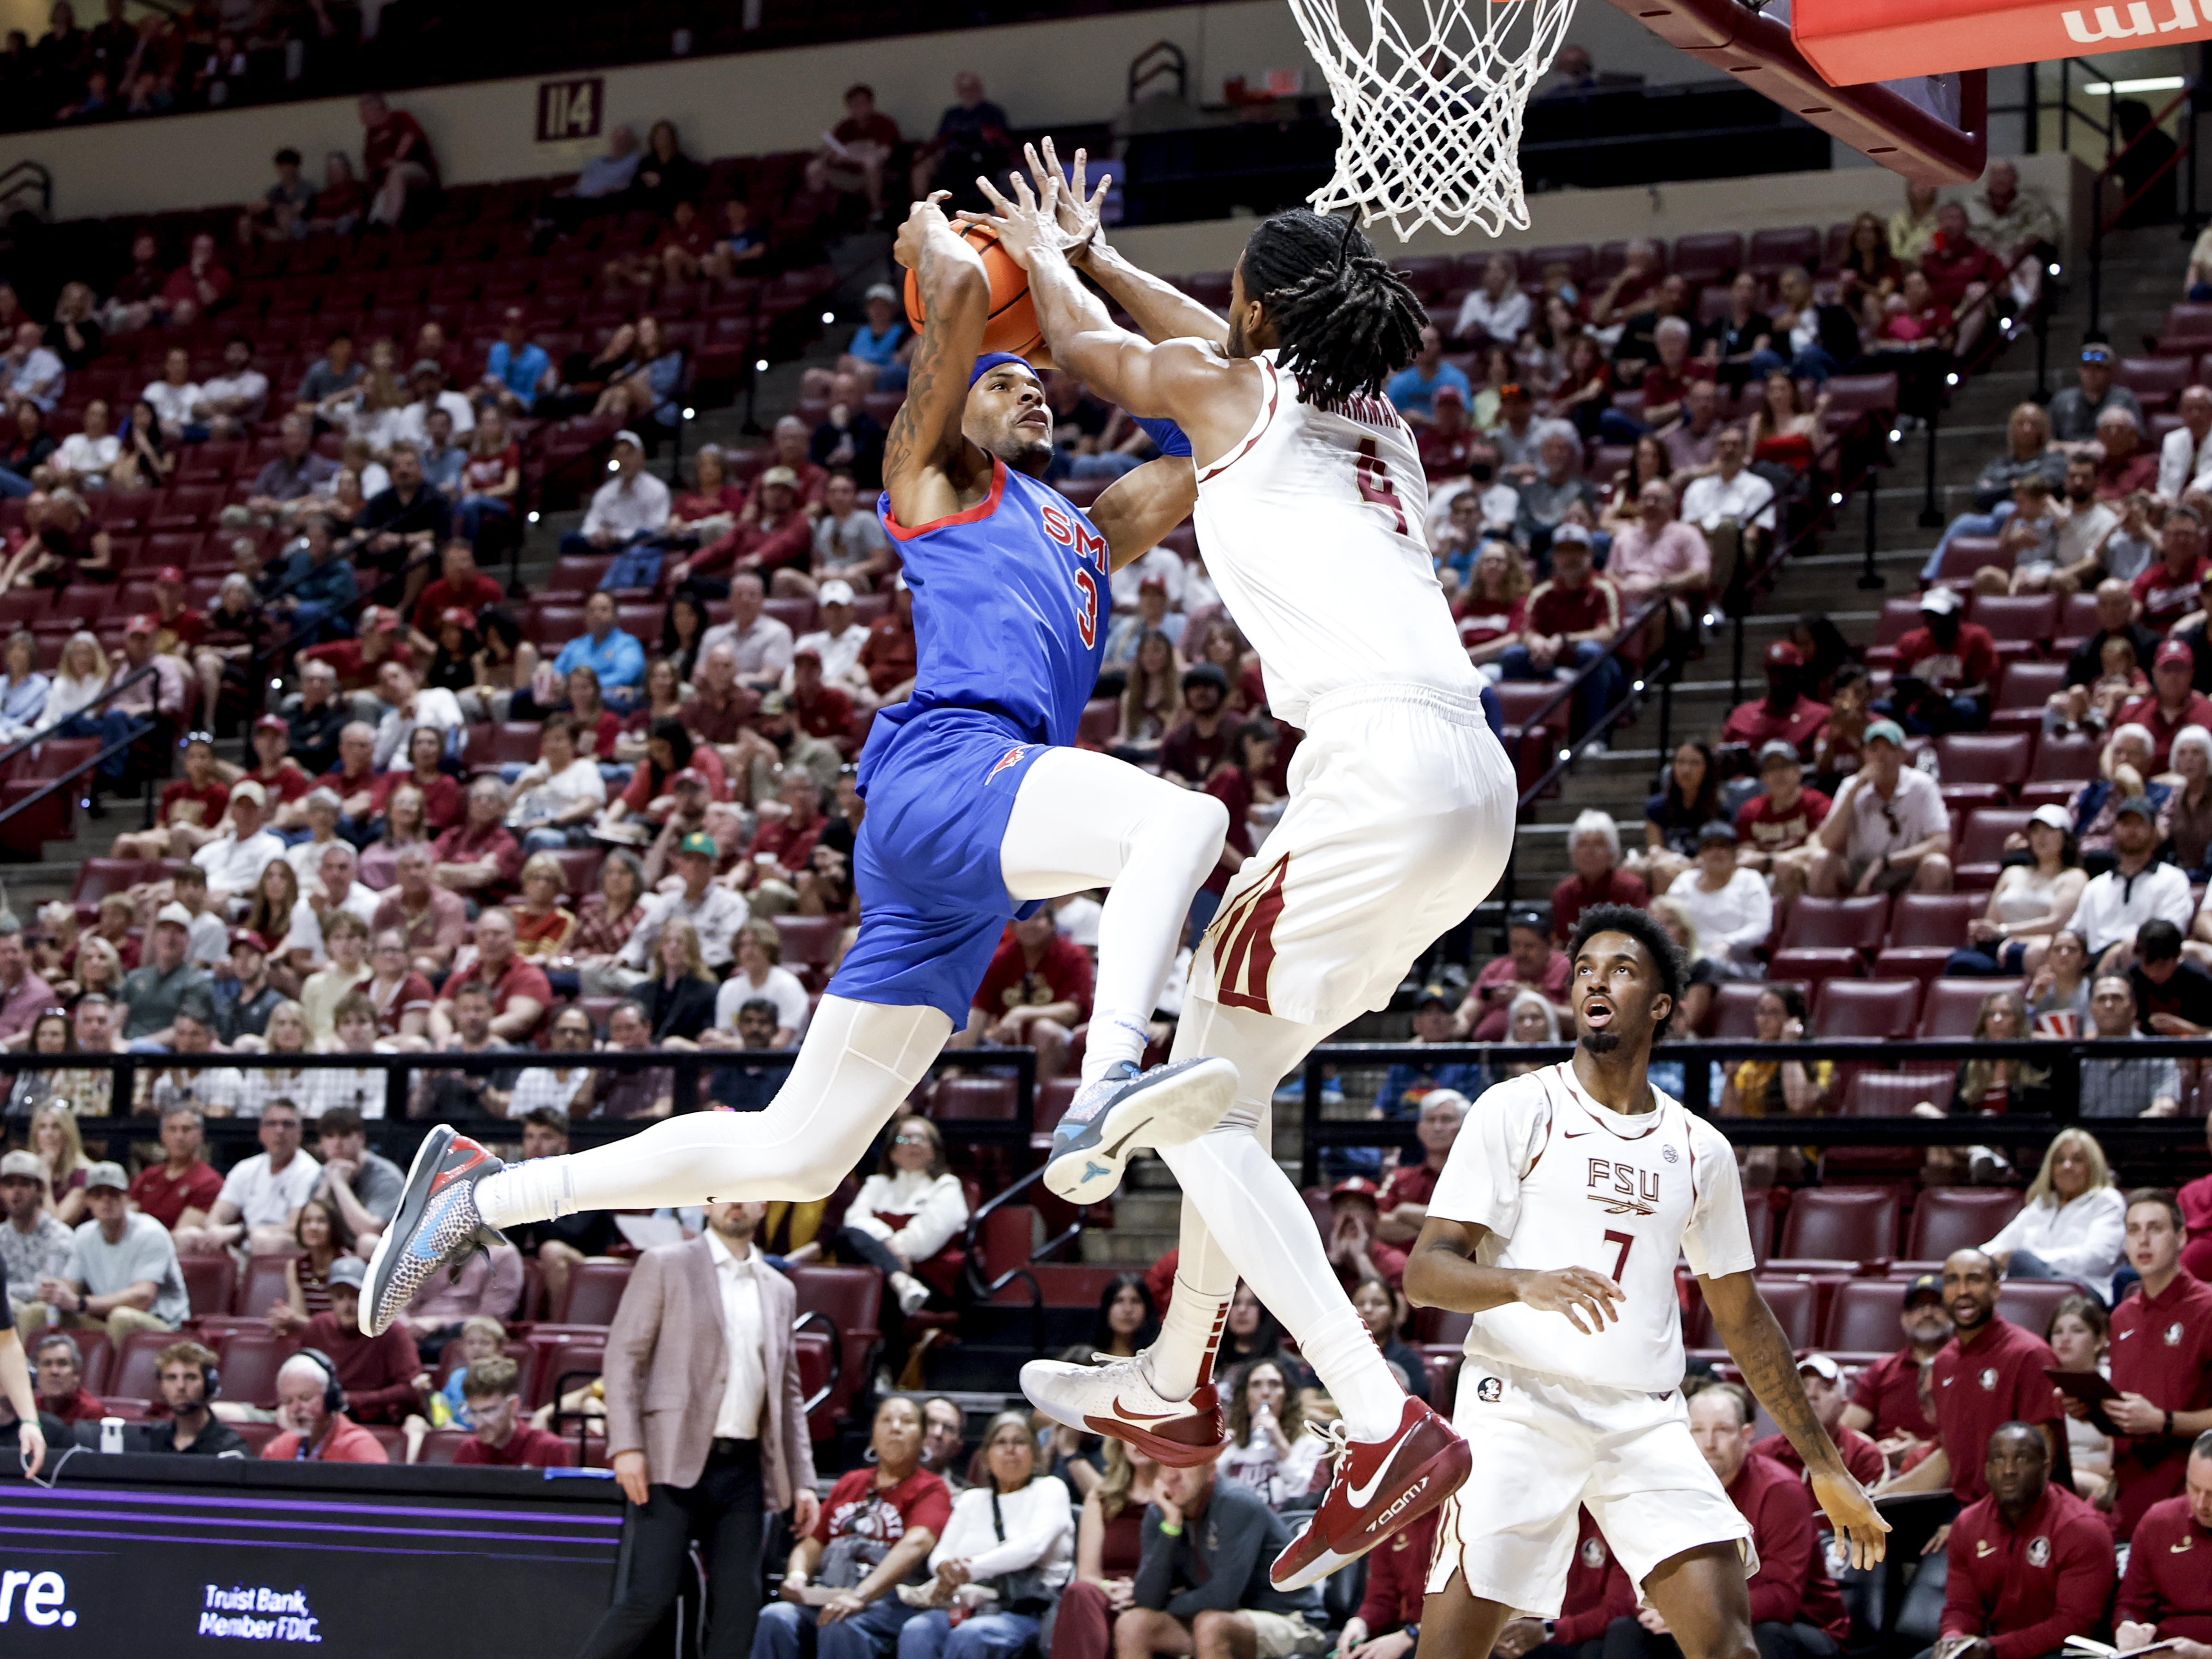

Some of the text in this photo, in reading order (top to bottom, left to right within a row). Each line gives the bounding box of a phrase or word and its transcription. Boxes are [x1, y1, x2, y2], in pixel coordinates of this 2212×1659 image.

[2061, 0, 2212, 42] rm
[546, 82, 593, 135] 114
[1354, 435, 1409, 536] 4
[1040, 505, 1112, 576] SM
[1075, 567, 1098, 650] 3
[1587, 1158, 1659, 1202] FSU
[1602, 1229, 1636, 1284] 7
[0, 1570, 78, 1628] re.
[206, 1584, 309, 1618] Truist Bank,
[198, 1612, 323, 1642] Member FDIC.
